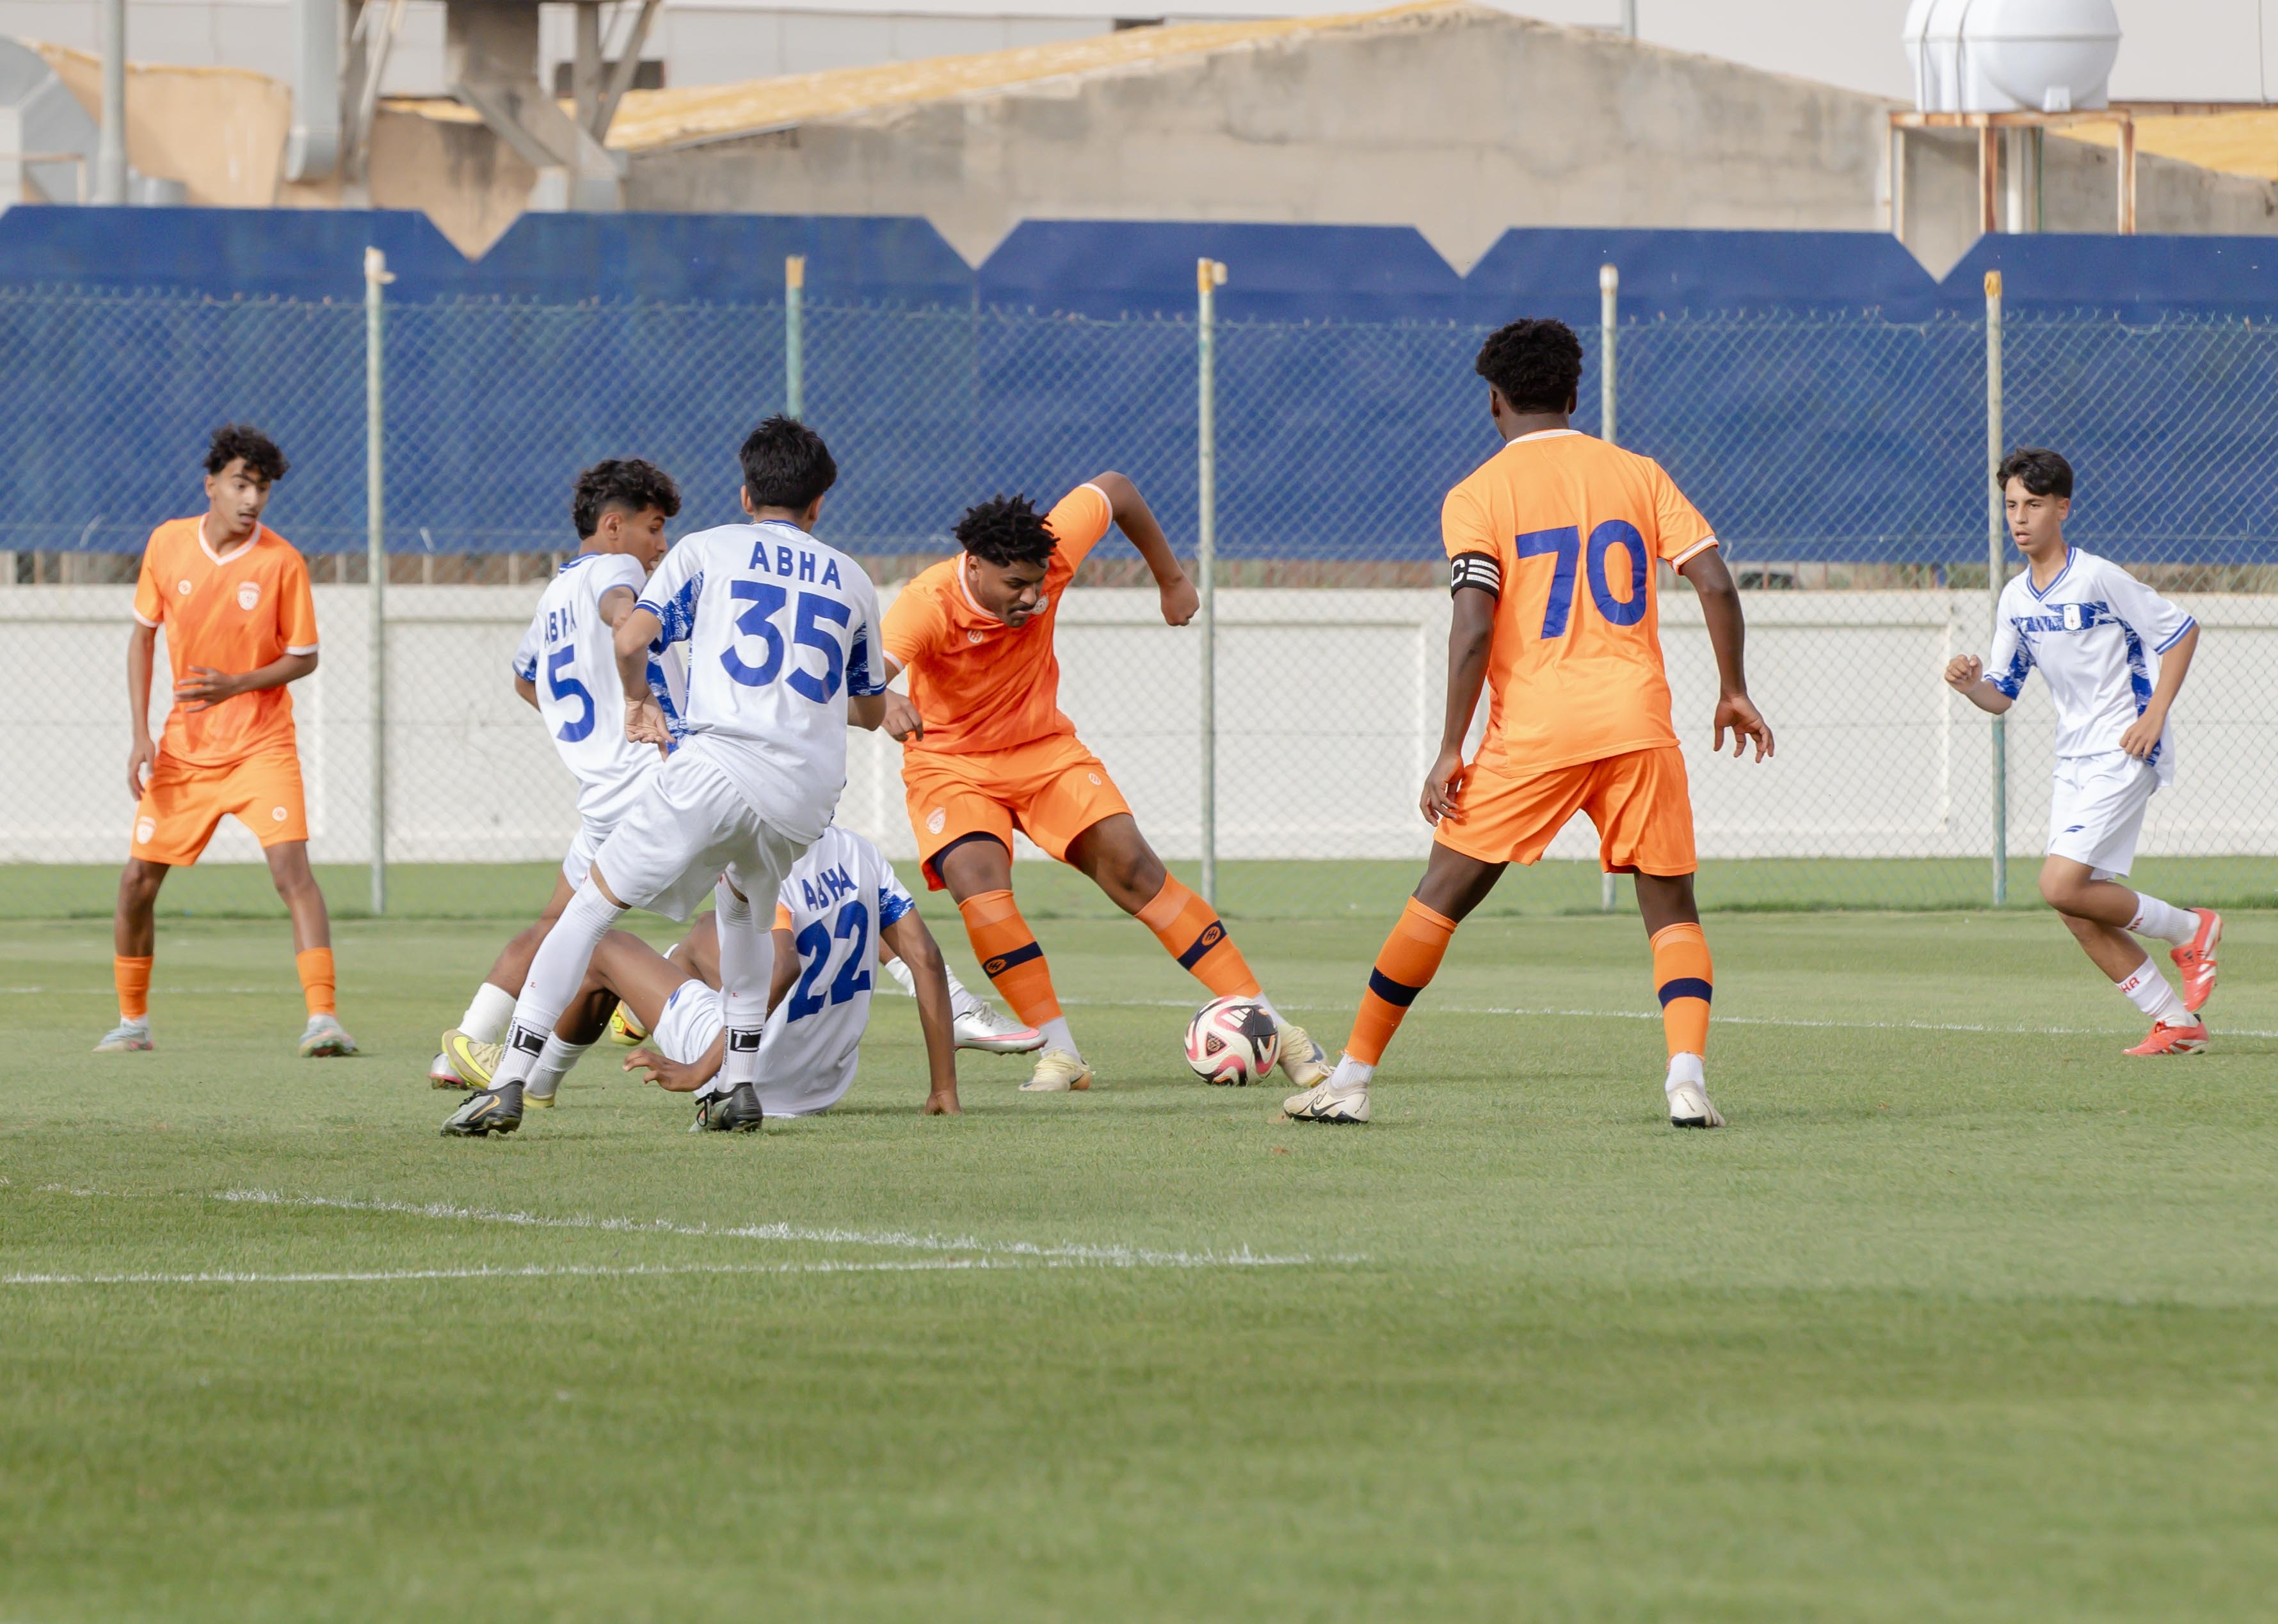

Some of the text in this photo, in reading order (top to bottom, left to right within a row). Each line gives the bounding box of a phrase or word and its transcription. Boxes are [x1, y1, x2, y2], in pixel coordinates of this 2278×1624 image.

[748, 541, 842, 590] ABHA
[1516, 519, 1647, 639] 70
[544, 600, 577, 649] ABHA
[720, 580, 851, 704] 35
[547, 644, 595, 742] 5
[801, 862, 858, 912] ABHA
[787, 900, 871, 1023] 22
